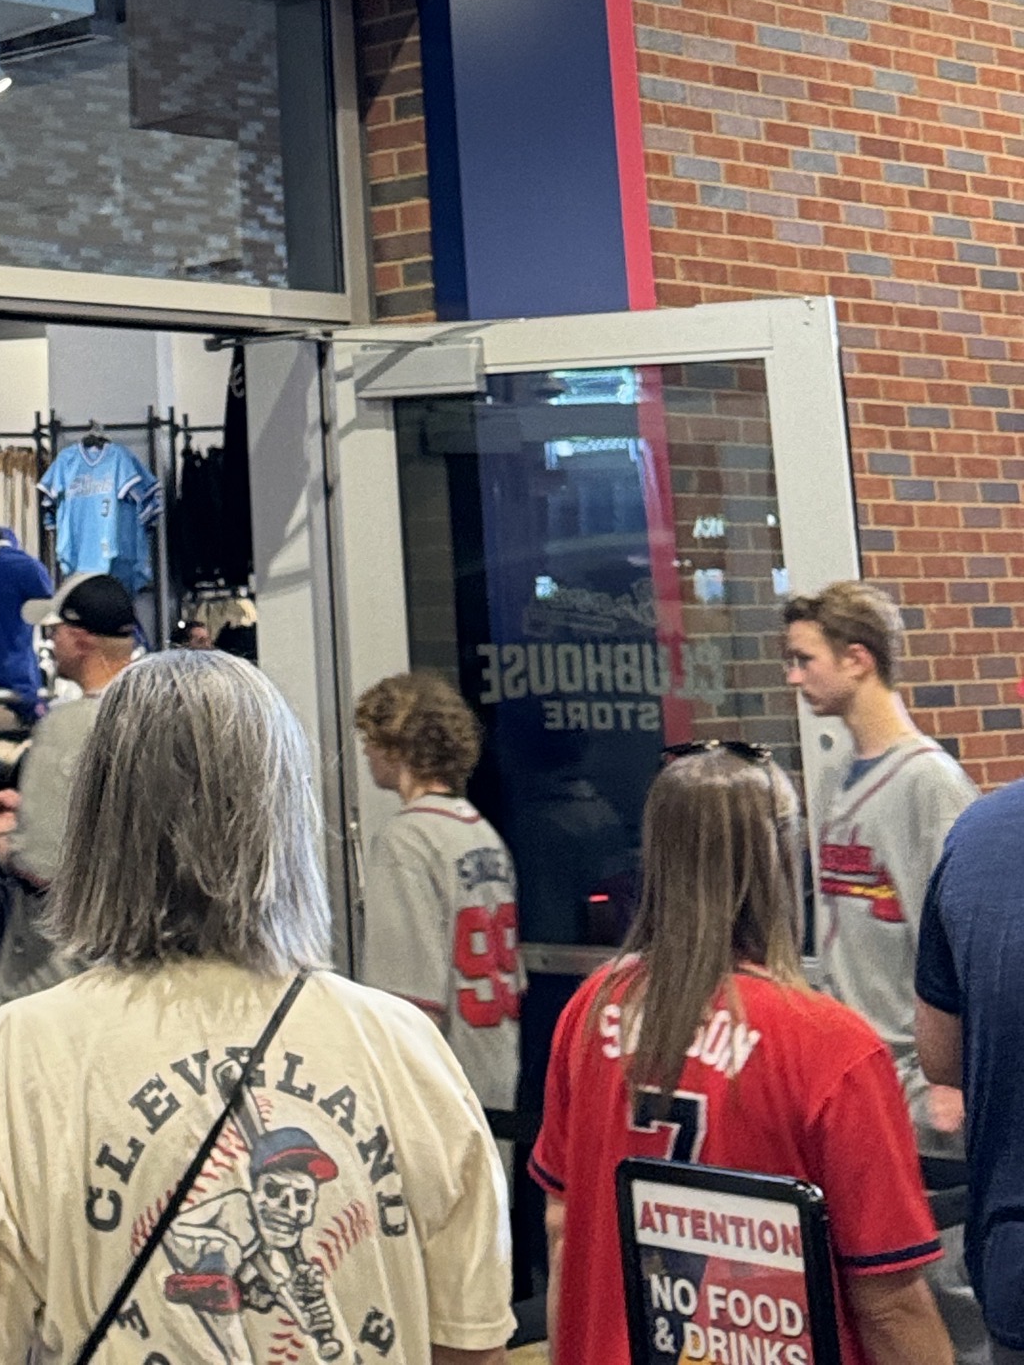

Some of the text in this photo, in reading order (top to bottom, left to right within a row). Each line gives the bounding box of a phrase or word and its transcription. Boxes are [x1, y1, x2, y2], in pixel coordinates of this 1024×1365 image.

[629, 1086, 707, 1164] 7
[638, 1201, 802, 1258] ATTENTION
[650, 1273, 804, 1337] NO FOOD
[653, 1316, 677, 1354] &
